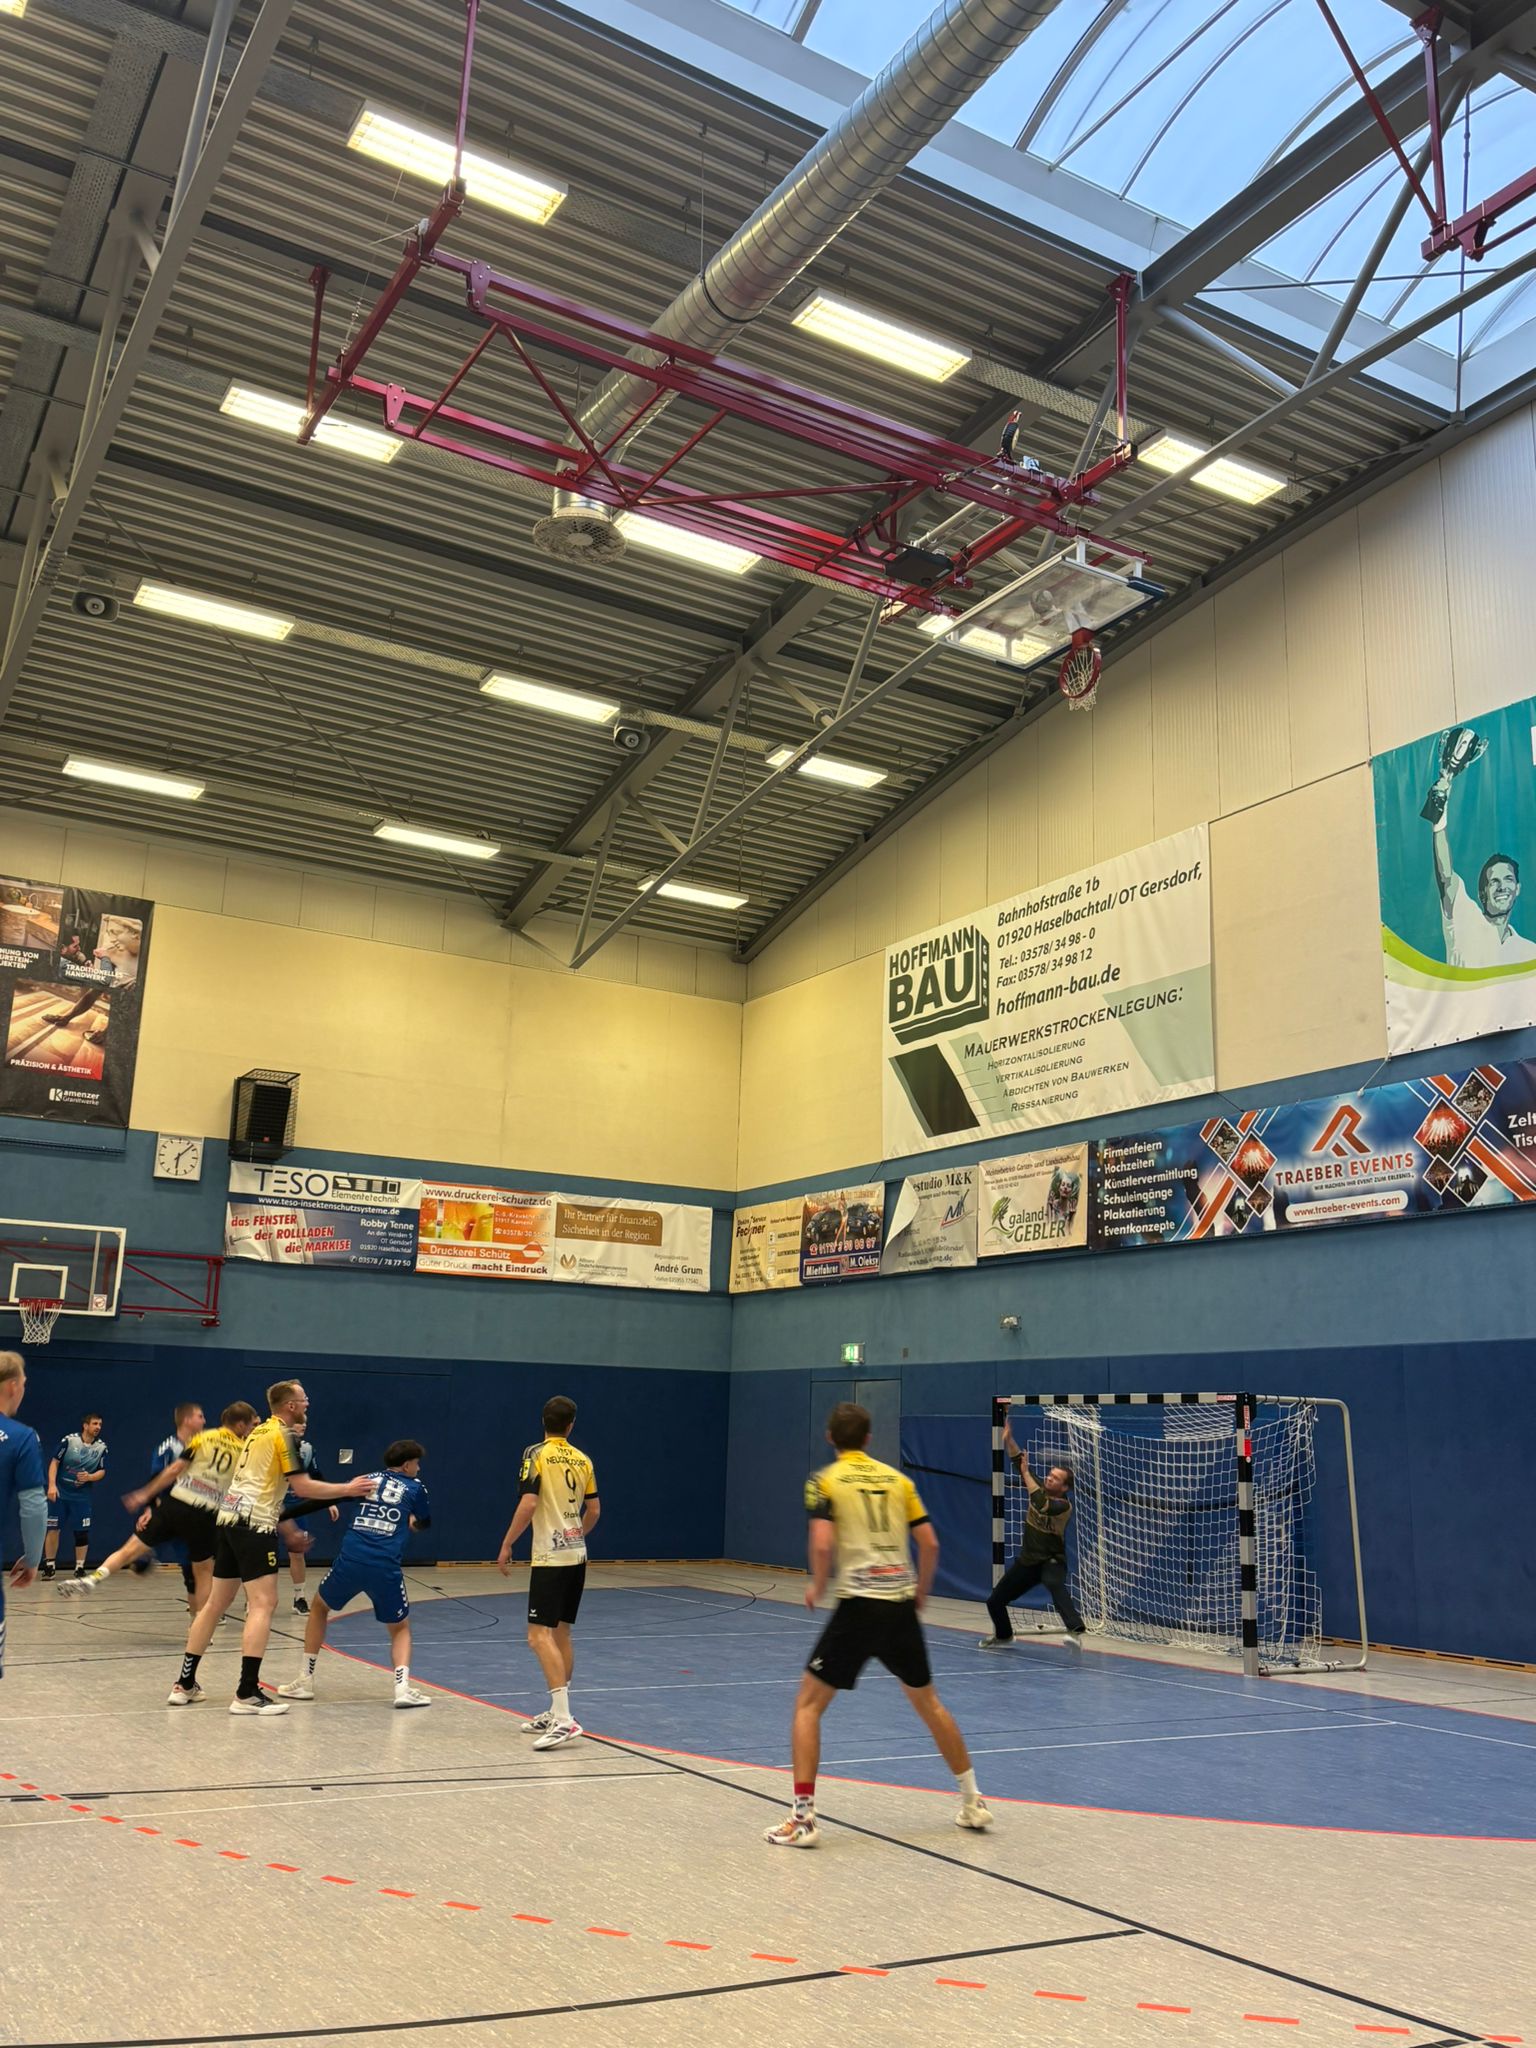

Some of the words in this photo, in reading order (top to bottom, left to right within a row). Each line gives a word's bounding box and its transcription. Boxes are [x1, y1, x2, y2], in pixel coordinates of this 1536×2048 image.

[997, 884, 1082, 926] Bahnhofstraße
[1086, 876, 1100, 895] 1b
[997, 924, 1032, 949] 01920
[1139, 861, 1202, 897] Gersdorf,
[23, 951, 39, 959] VON
[889, 925, 974, 978] HOFFMANN
[1000, 954, 1018, 969] Tel.:
[1020, 940, 1053, 962] 03578/
[1055, 936, 1066, 951] 34
[1068, 932, 1080, 946] 98
[65, 970, 107, 981] HANDWERK
[66, 964, 123, 977] TRADITIONELLES
[996, 975, 1016, 988] Fax:
[1065, 952, 1078, 966] 98
[1080, 947, 1093, 961] 12
[888, 950, 974, 1024] BAU
[996, 964, 1121, 1016] hoffmann-bau.de
[10, 1058, 50, 1070] PRÄZISION
[58, 1063, 92, 1075] ÄSTHETIK
[1103, 1141, 1162, 1159] Firmenfeiern
[1104, 1158, 1155, 1174] Hochzeiten
[1275, 1163, 1343, 1187] TRAEBER
[1350, 1152, 1414, 1176] EVENTS
[254, 1168, 329, 1196] TESO
[1104, 1167, 1198, 1190] Künstlervermittlung
[258, 1196, 400, 1216] www.teso-insektenschutzsysteme.de
[331, 1190, 400, 1204] Elementetechnik
[425, 1188, 552, 1207] www.druckerei-schuetz.de
[1103, 1188, 1173, 1205] Schuleingänge
[1103, 1205, 1166, 1220] Plakatierung
[1293, 1196, 1401, 1217] www.traeber-events.com
[231, 1217, 250, 1227] das
[253, 1214, 298, 1226] FENSTER
[360, 1218, 388, 1230] Robby
[389, 1220, 415, 1231] Tenne
[564, 1208, 576, 1219] Ihr
[577, 1211, 605, 1223] Partner
[606, 1213, 618, 1224] für
[619, 1214, 658, 1227] finanzielle
[1009, 1206, 1048, 1229] galand-
[254, 1230, 274, 1241] der
[276, 1227, 334, 1239] ROLLLADEN
[562, 1223, 600, 1236] Sicherheit
[602, 1226, 610, 1236] in
[611, 1229, 624, 1239] der
[625, 1230, 653, 1242] Region.
[1014, 1220, 1066, 1243] GEBLER
[1104, 1220, 1176, 1236] Eventkonzepte
[285, 1242, 302, 1253] die
[305, 1240, 351, 1252] MARKISE
[430, 1245, 477, 1257] Druckerei
[479, 1247, 511, 1260] Schütz
[471, 1262, 503, 1272] macht
[505, 1264, 548, 1275] Eindruck
[654, 1263, 679, 1273] André
[681, 1265, 703, 1274] Grum
[850, 1257, 857, 1268] M.
[209, 1447, 232, 1474] 10
[360, 1502, 401, 1522] TESO
[857, 1488, 889, 1533] 17
[267, 1551, 277, 1567] 5
